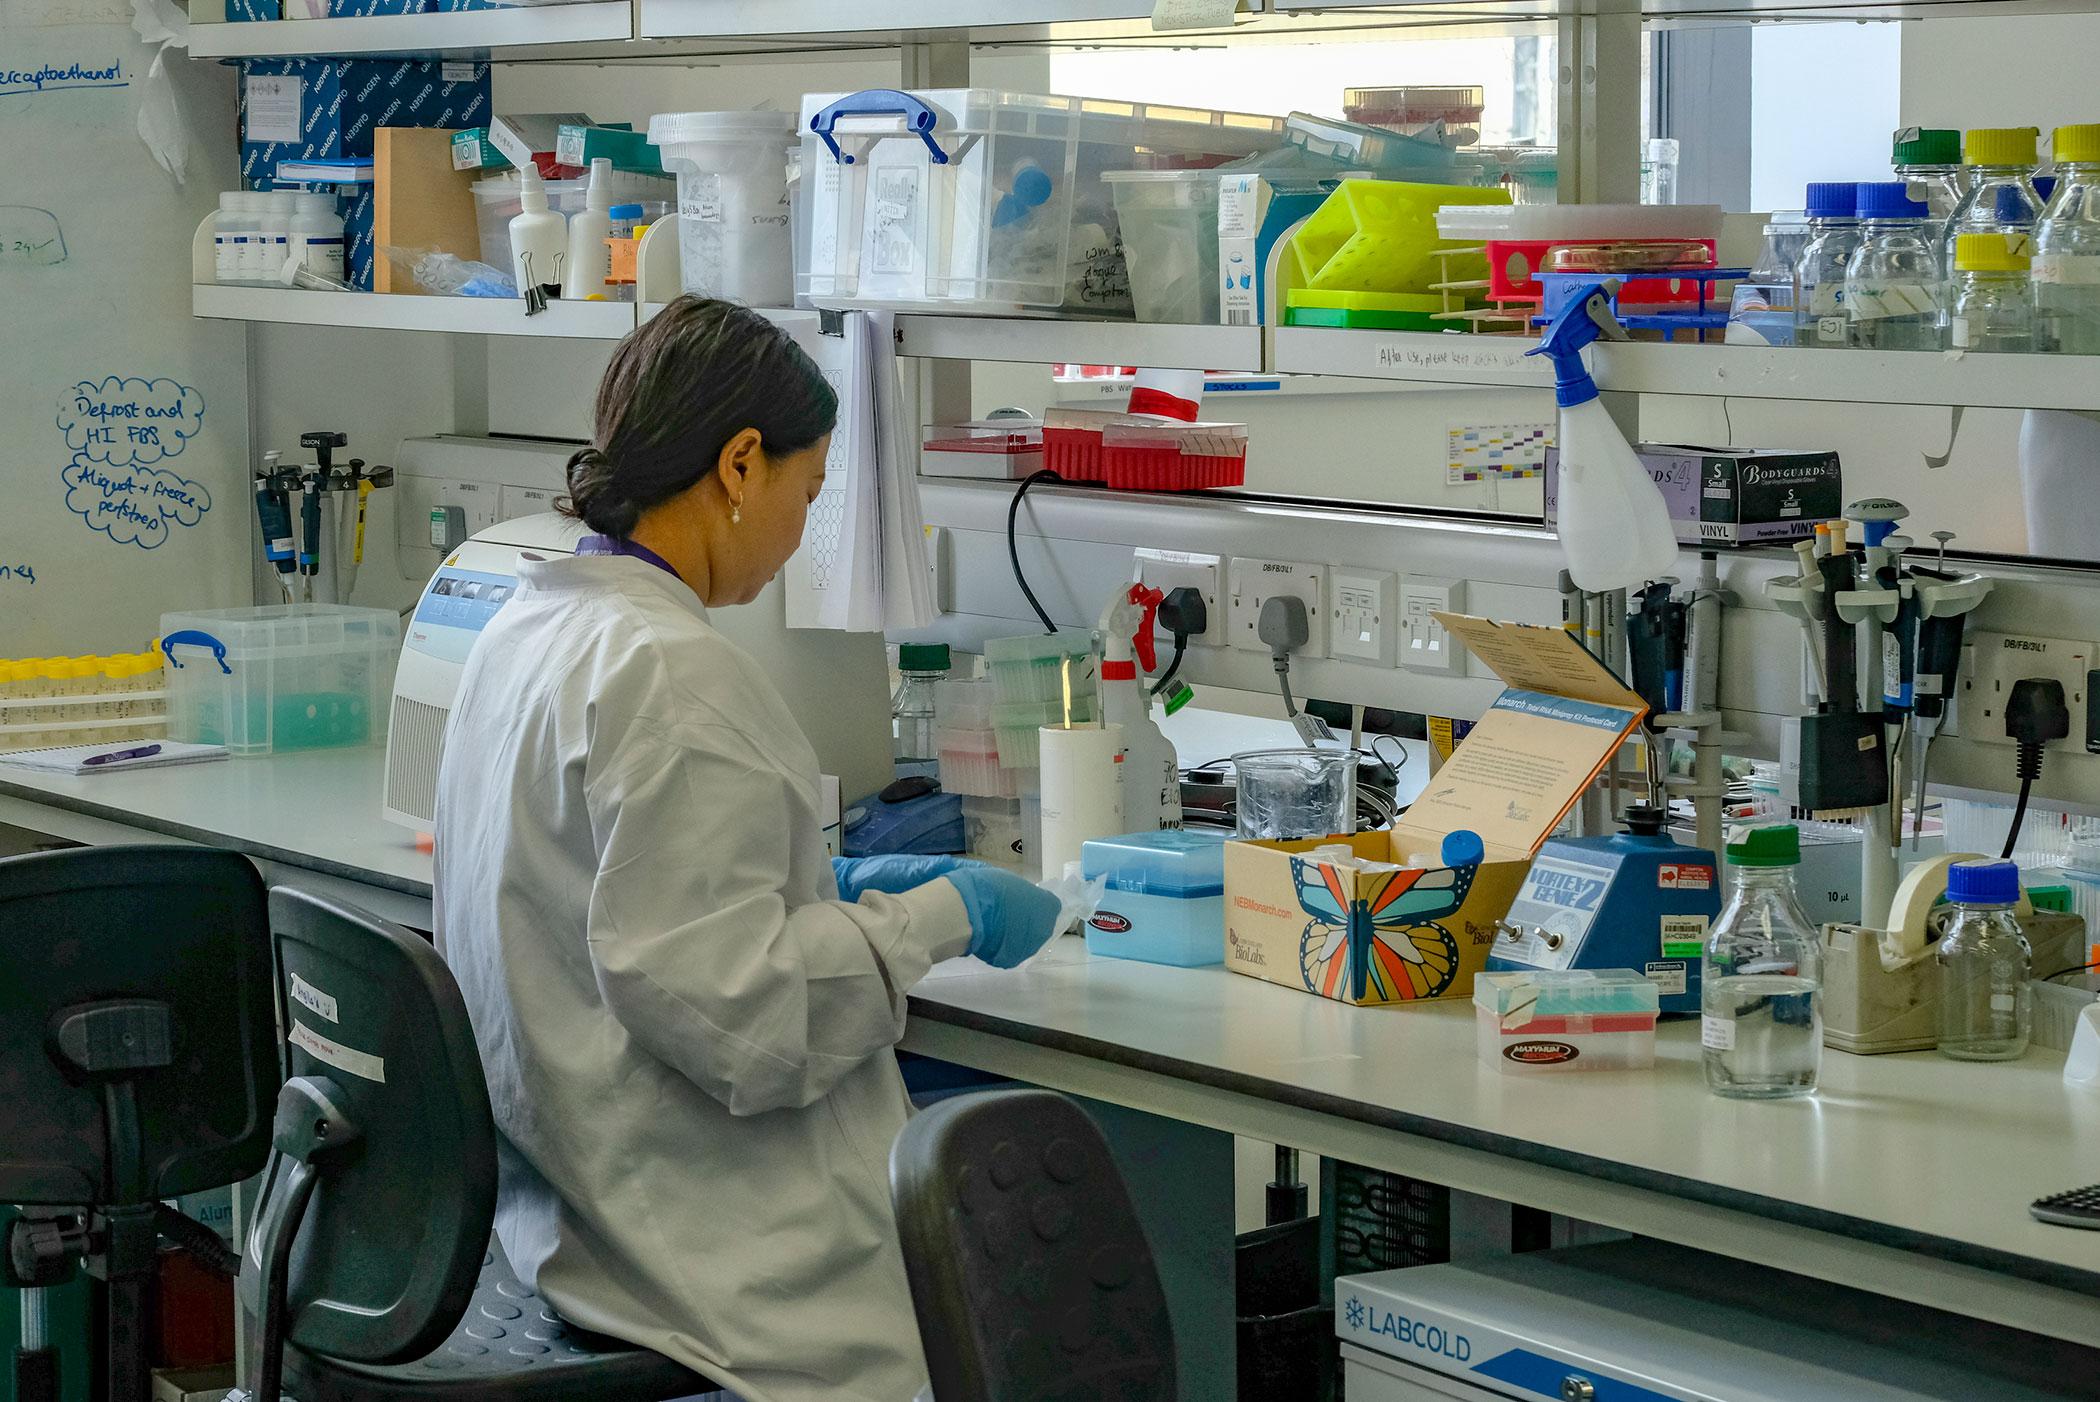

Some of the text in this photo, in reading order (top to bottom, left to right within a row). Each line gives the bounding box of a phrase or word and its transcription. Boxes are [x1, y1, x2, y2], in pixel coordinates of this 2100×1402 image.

[314, 64, 331, 94] QIAGEN
[356, 73, 382, 103] QIAGEN
[328, 89, 348, 118] QIAGEN
[409, 83, 433, 112] QIAGEN
[461, 92, 485, 122] QIAGEN
[305, 103, 324, 133] QIAGEN
[377, 98, 402, 127] QIAGEN
[344, 113, 369, 143] QIAGEN
[319, 127, 338, 158] QIAGEN
[243, 149, 258, 177] QIAGEN
[354, 192, 369, 221] QIAGEN
[349, 231, 362, 260] QIAGEN
[360, 256, 373, 285] QIAGEN
[1100, 384, 1133, 394] PBS Wat
[75, 397, 184, 424] Defrost and
[86, 426, 160, 446] HI FBS
[1707, 479, 1728, 489] Small
[1713, 463, 1722, 479] S
[78, 466, 137, 497] Aliquot
[153, 480, 196, 508] freeze
[282, 481, 350, 490] 3 4
[1787, 488, 1795, 501] S
[1783, 500, 1799, 508] Small
[1700, 523, 1729, 538] VINYL
[1790, 521, 1818, 536] VINY
[1496, 697, 1526, 710] Monarch
[1603, 719, 1618, 728] Card
[1234, 895, 1293, 921] NEBMonarch.com
[1532, 886, 1579, 908] GENIE
[1574, 879, 1606, 912] 2
[1827, 891, 1839, 903] 10
[1235, 943, 1267, 966] BioLabs
[1514, 1045, 1561, 1054] MAXYMUM
[1369, 1306, 1471, 1362] LABCOLD
